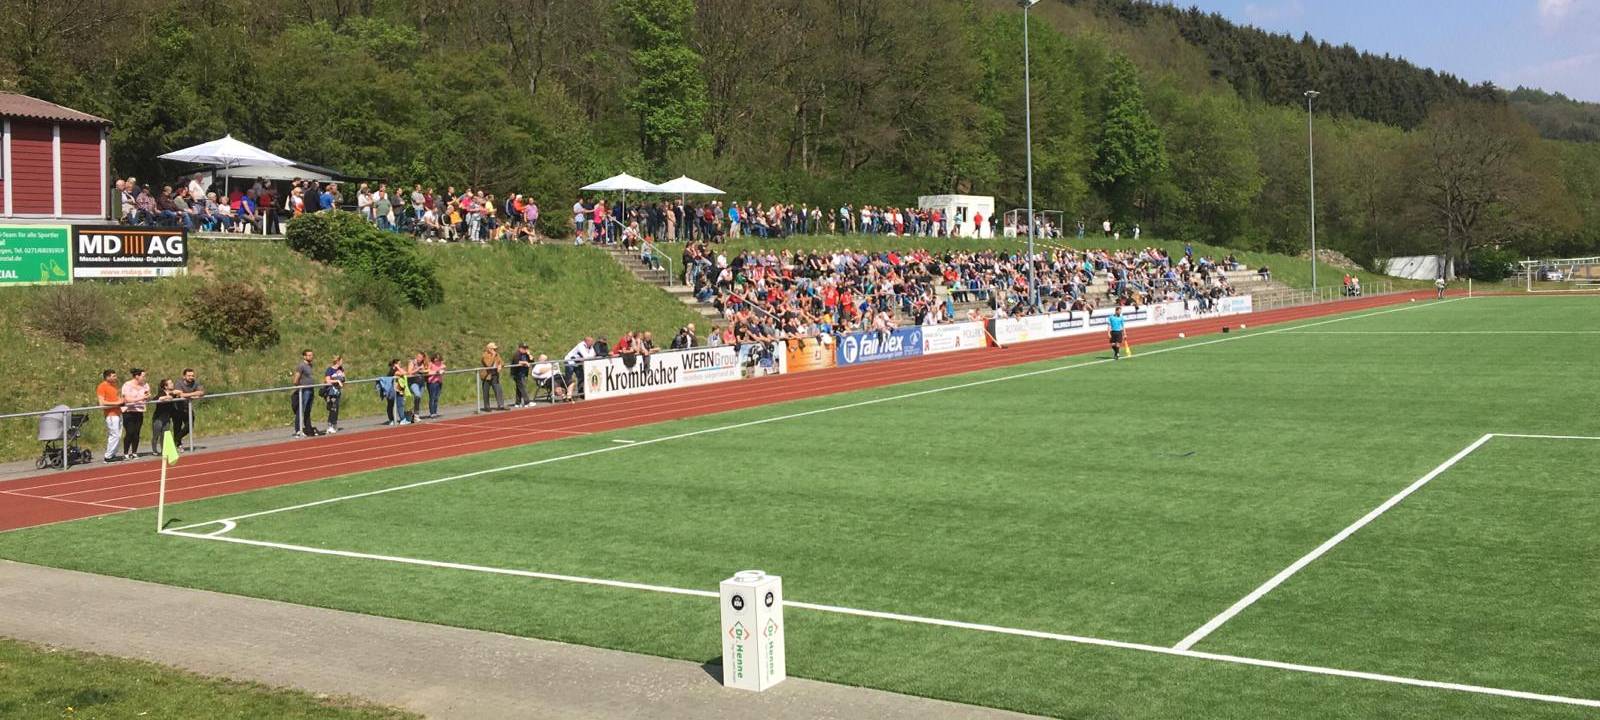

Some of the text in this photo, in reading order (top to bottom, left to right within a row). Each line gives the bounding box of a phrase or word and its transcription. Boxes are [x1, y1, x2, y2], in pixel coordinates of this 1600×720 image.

[79, 235, 183, 254] MD AG
[605, 360, 678, 391] Krombacher
[736, 644, 744, 679] Henne
